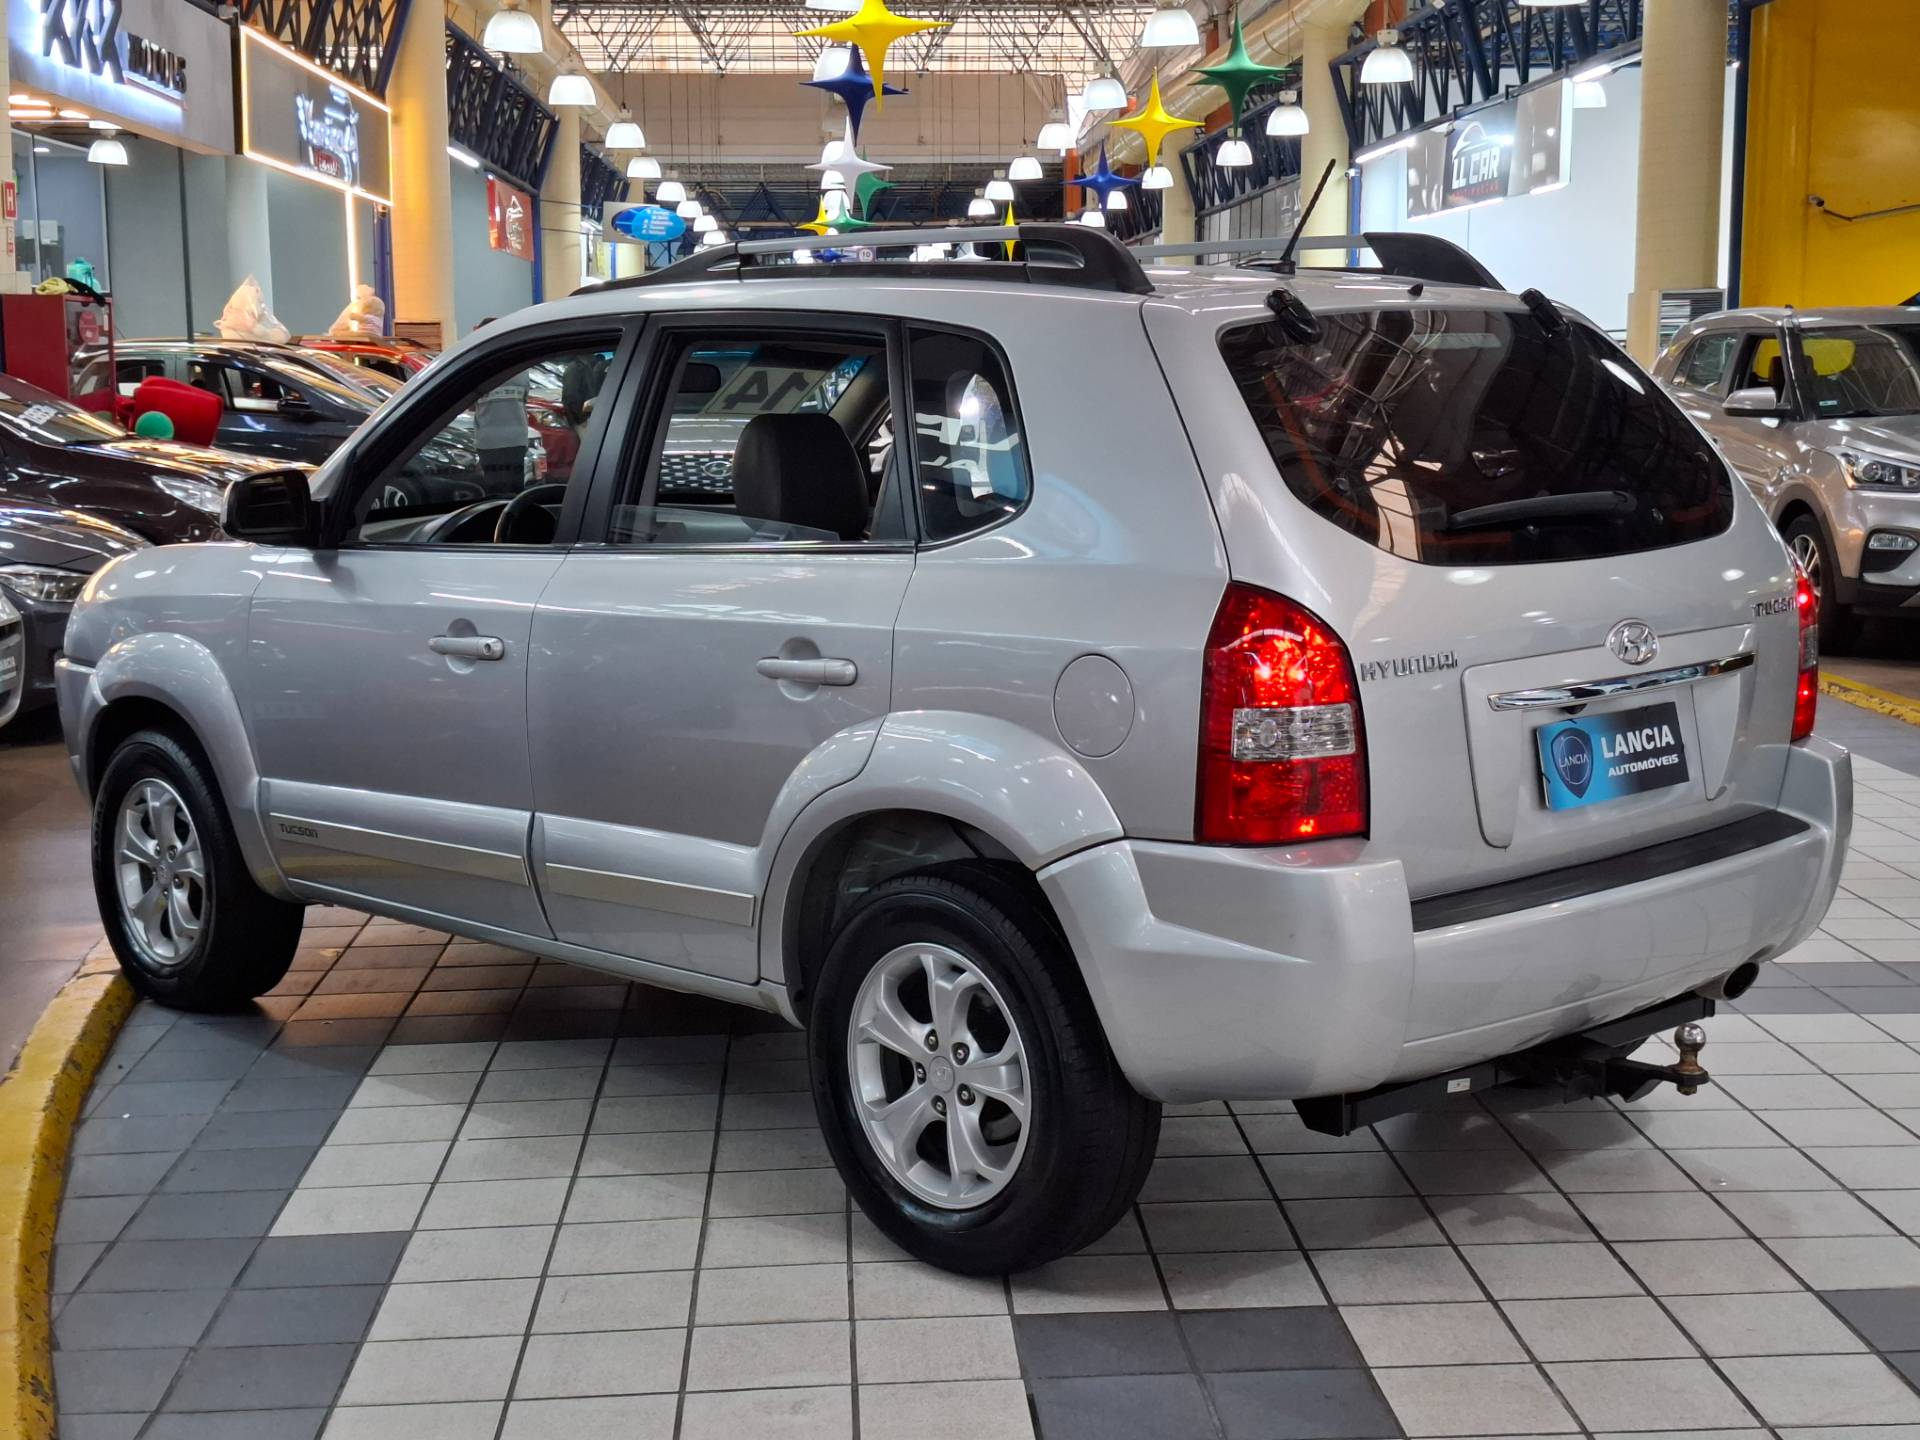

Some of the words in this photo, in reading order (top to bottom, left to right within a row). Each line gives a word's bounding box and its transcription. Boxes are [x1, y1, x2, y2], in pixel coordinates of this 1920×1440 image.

[1469, 147, 1500, 185] CAR
[1360, 650, 1458, 682] HYUNDAI
[1601, 724, 1676, 759] LANCIA
[1559, 753, 1590, 768] LANCIA
[1608, 753, 1680, 778] AUTOMÓVEIS
[279, 823, 319, 839] TUCSON
